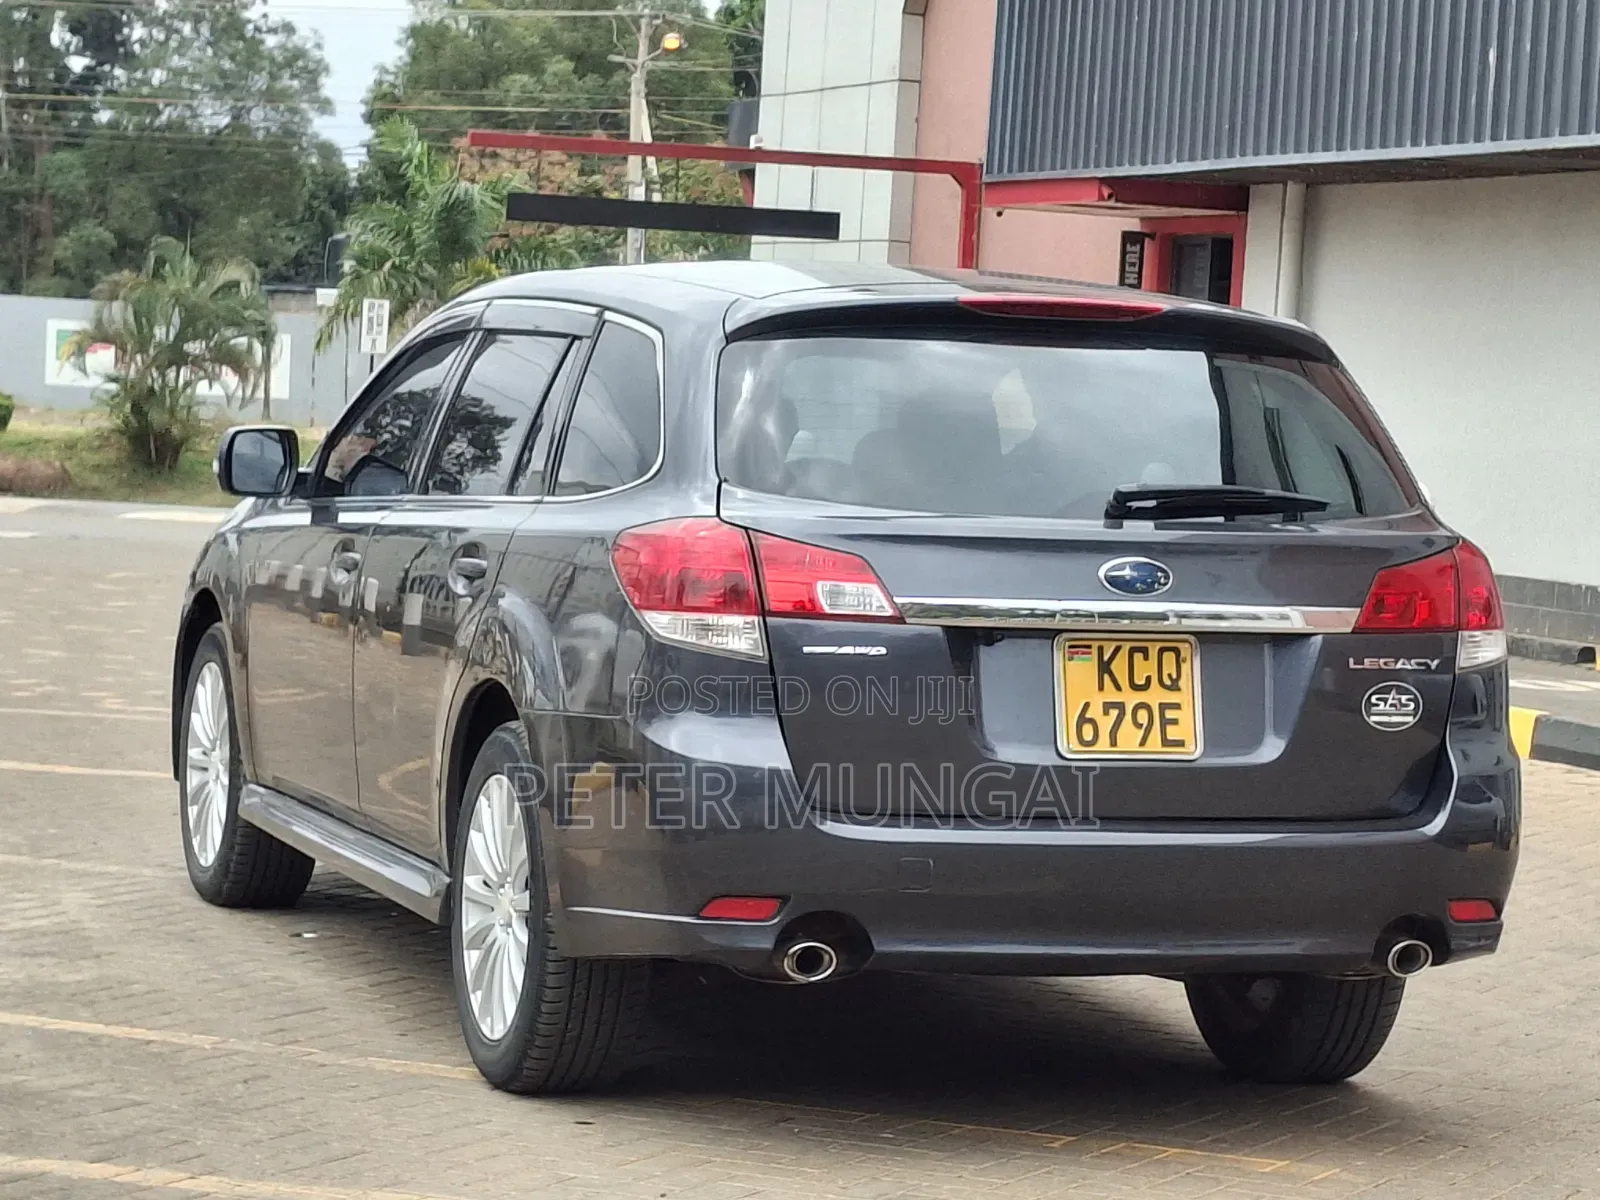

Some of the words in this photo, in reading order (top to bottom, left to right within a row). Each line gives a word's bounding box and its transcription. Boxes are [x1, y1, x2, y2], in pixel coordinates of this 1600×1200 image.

[1096, 645, 1182, 692] KCQ
[1348, 657, 1440, 670] LEGACY
[1075, 701, 1185, 748] 679E
